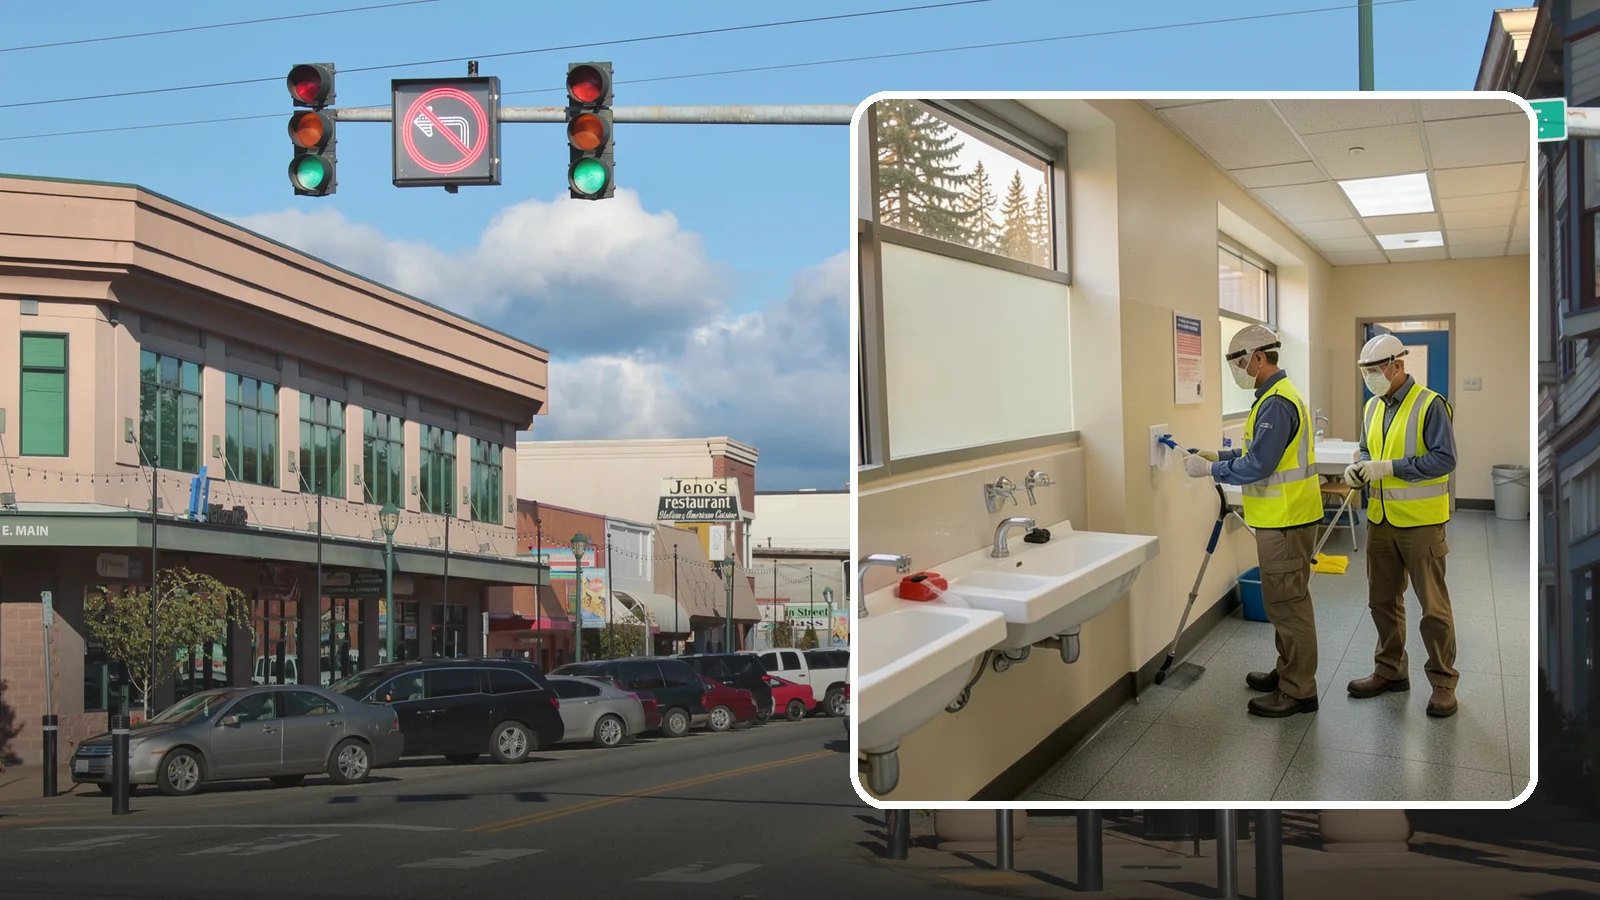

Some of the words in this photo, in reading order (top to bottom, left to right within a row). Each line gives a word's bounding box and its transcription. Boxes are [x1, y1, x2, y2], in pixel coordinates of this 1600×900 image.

[669, 480, 727, 495] Jeno's
[665, 496, 731, 509] restaurant
[685, 509, 714, 519] American
[714, 509, 738, 519] Cuisine
[2, 525, 13, 536] E.
[15, 525, 49, 536] MAIN
[785, 607, 795, 617] in
[797, 607, 828, 617] Street
[790, 619, 824, 627] lass
